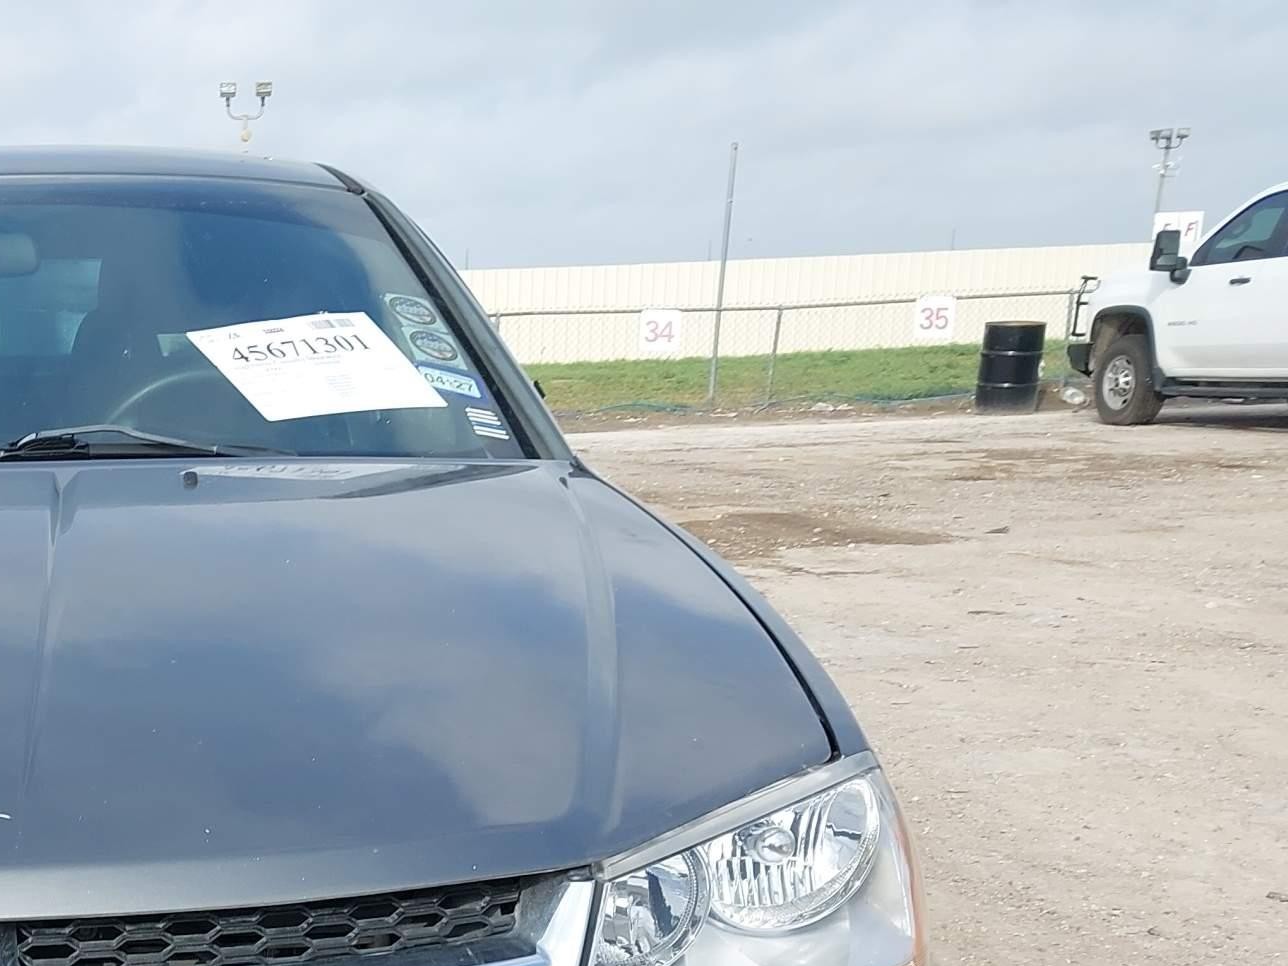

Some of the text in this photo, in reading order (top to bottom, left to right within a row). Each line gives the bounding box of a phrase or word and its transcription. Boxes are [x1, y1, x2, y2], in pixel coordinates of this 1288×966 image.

[919, 307, 949, 330] 35
[644, 320, 675, 343] 34
[231, 333, 371, 363] 45671301
